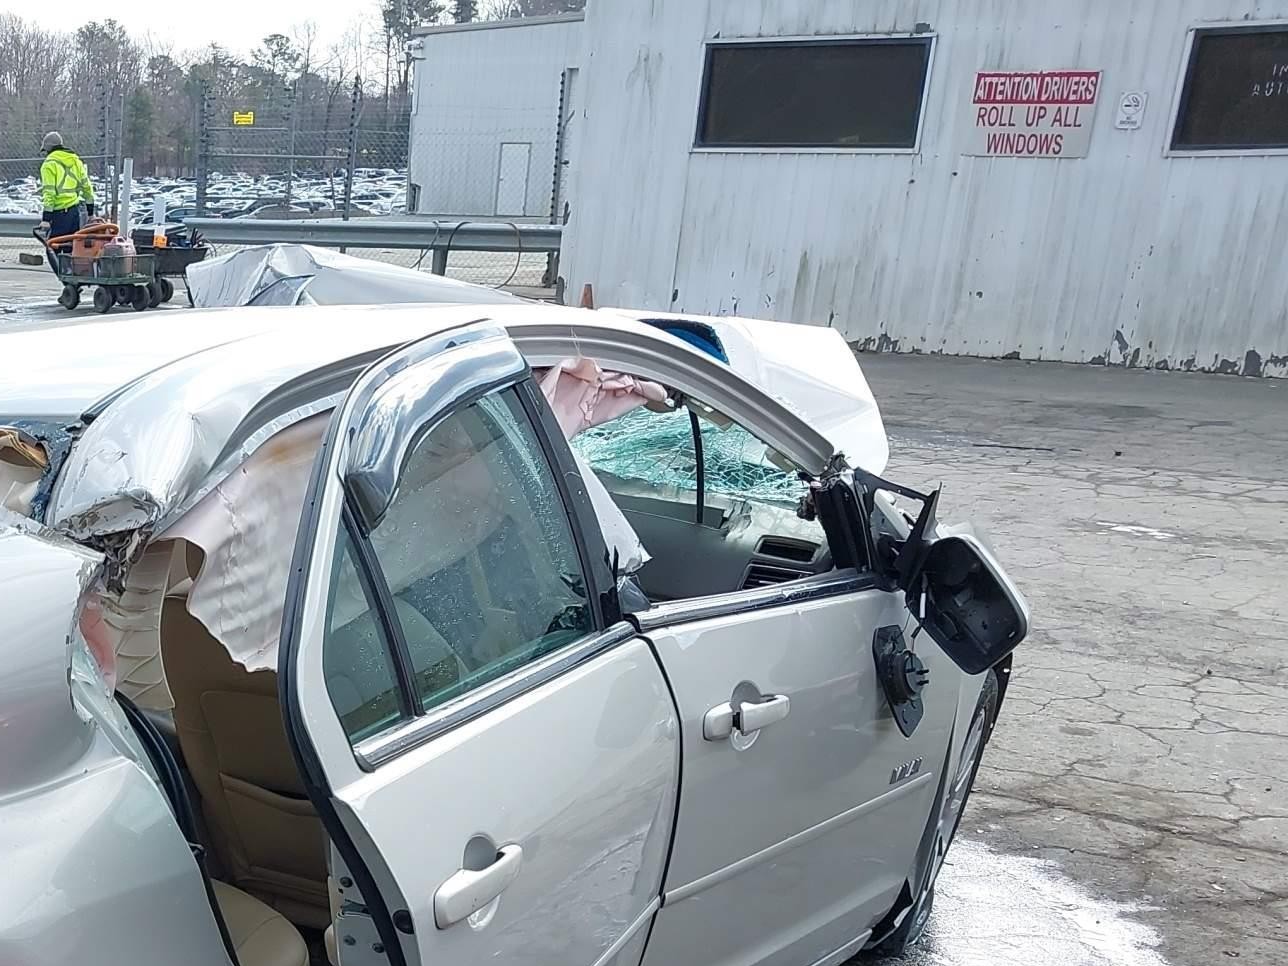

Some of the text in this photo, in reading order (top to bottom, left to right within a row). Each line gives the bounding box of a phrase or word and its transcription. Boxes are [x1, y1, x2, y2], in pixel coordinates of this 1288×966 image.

[975, 75, 1097, 101] ATTENTION DRIVERS
[976, 106, 1082, 127] ROLL UP ALL
[987, 133, 1064, 155] WINDOWS
